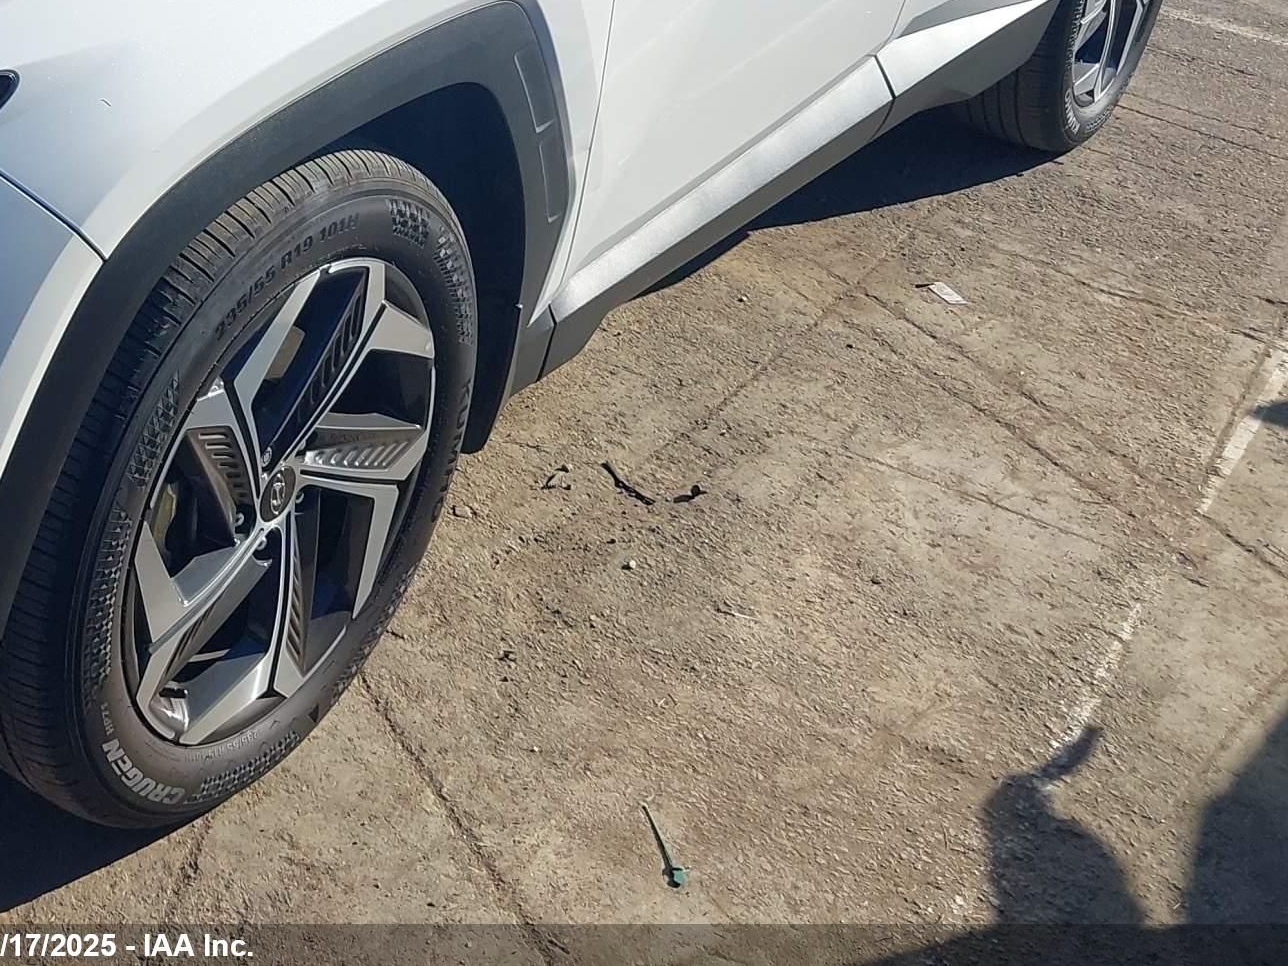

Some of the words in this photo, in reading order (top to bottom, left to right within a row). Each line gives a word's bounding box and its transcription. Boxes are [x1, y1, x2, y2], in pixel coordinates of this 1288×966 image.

[215, 265, 277, 341] 235/55
[280, 235, 314, 270] R19
[319, 212, 362, 243] 101H
[102, 738, 185, 805] CRUGEN
